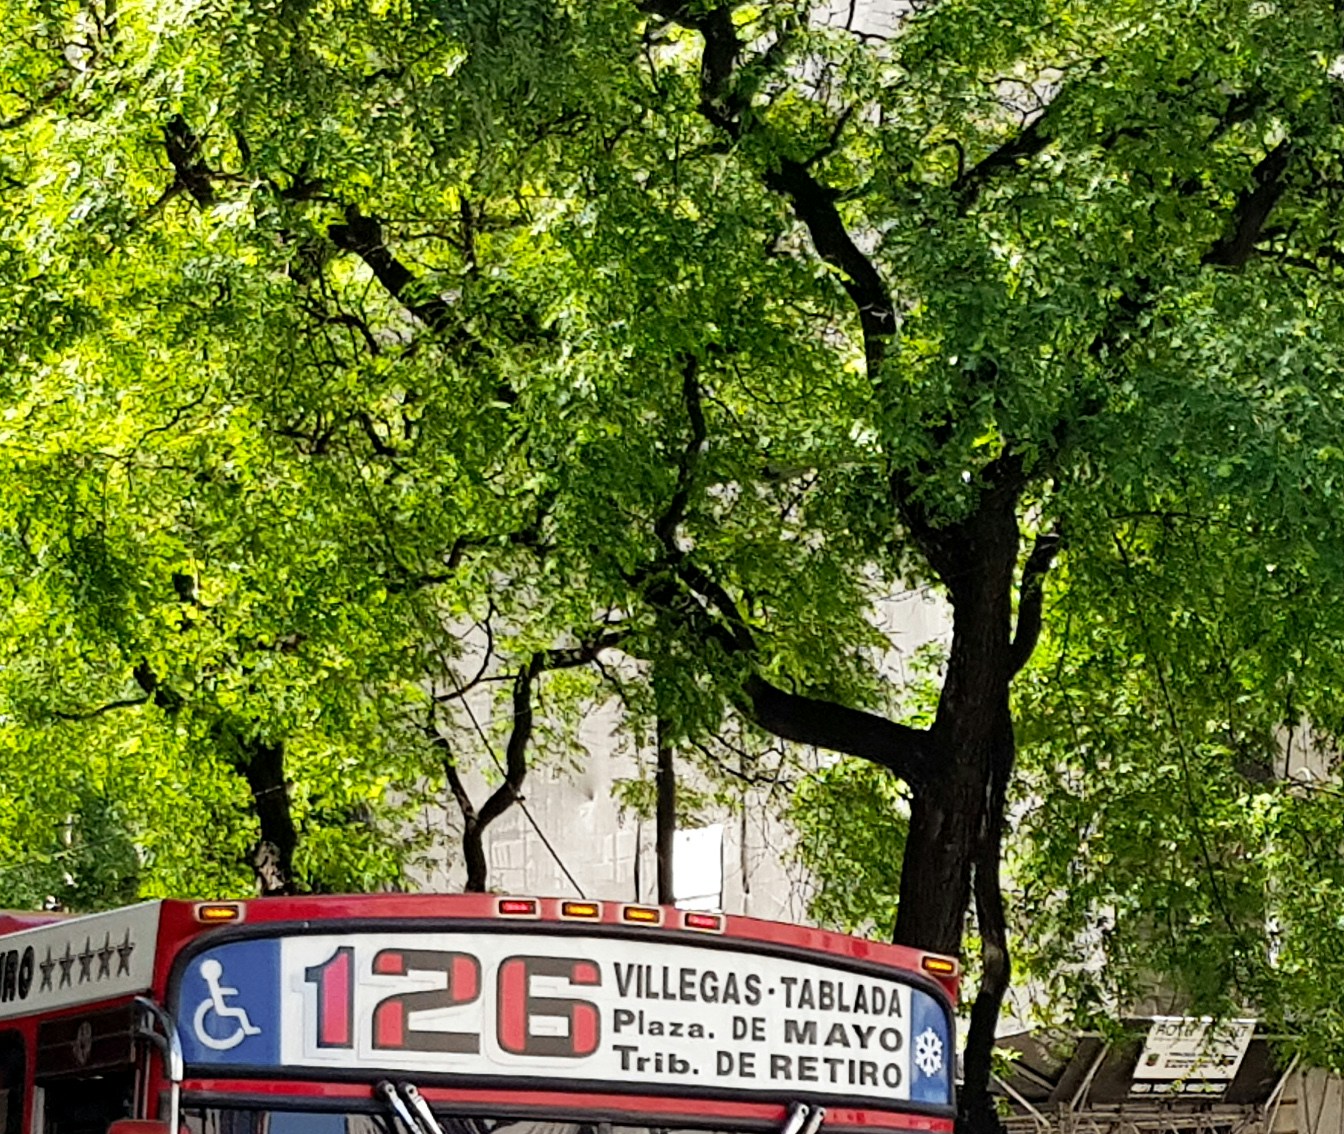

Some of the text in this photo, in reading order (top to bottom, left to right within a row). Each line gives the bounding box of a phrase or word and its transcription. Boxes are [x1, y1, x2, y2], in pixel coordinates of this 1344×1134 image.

[305, 946, 602, 1059] 126
[613, 1008, 903, 1052] Plaza. DE MAYO
[613, 1044, 902, 1088] Trib. DE RETIRO
